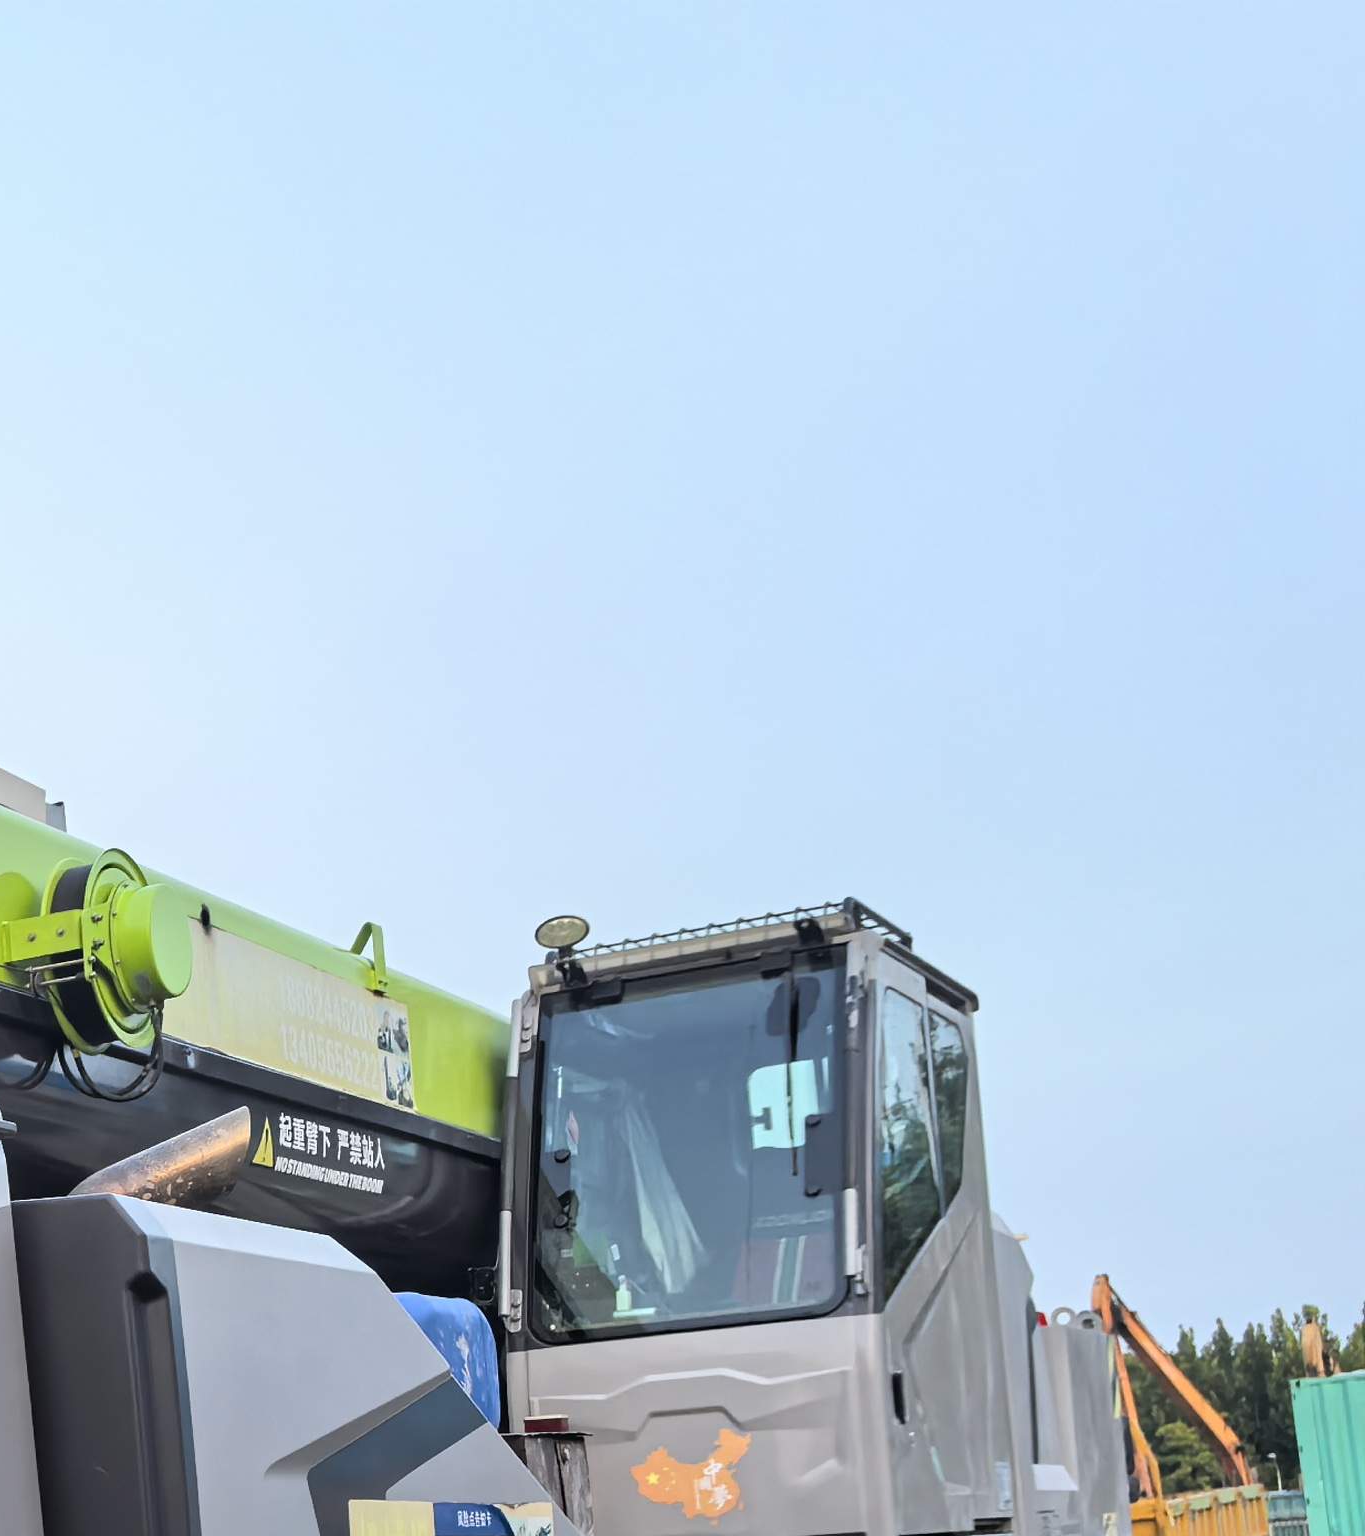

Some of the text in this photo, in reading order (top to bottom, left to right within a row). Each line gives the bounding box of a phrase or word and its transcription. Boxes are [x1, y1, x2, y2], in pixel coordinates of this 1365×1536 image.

[279, 1112, 386, 1170] 起重臂下 严禁站人
[274, 1156, 289, 1174] NO
